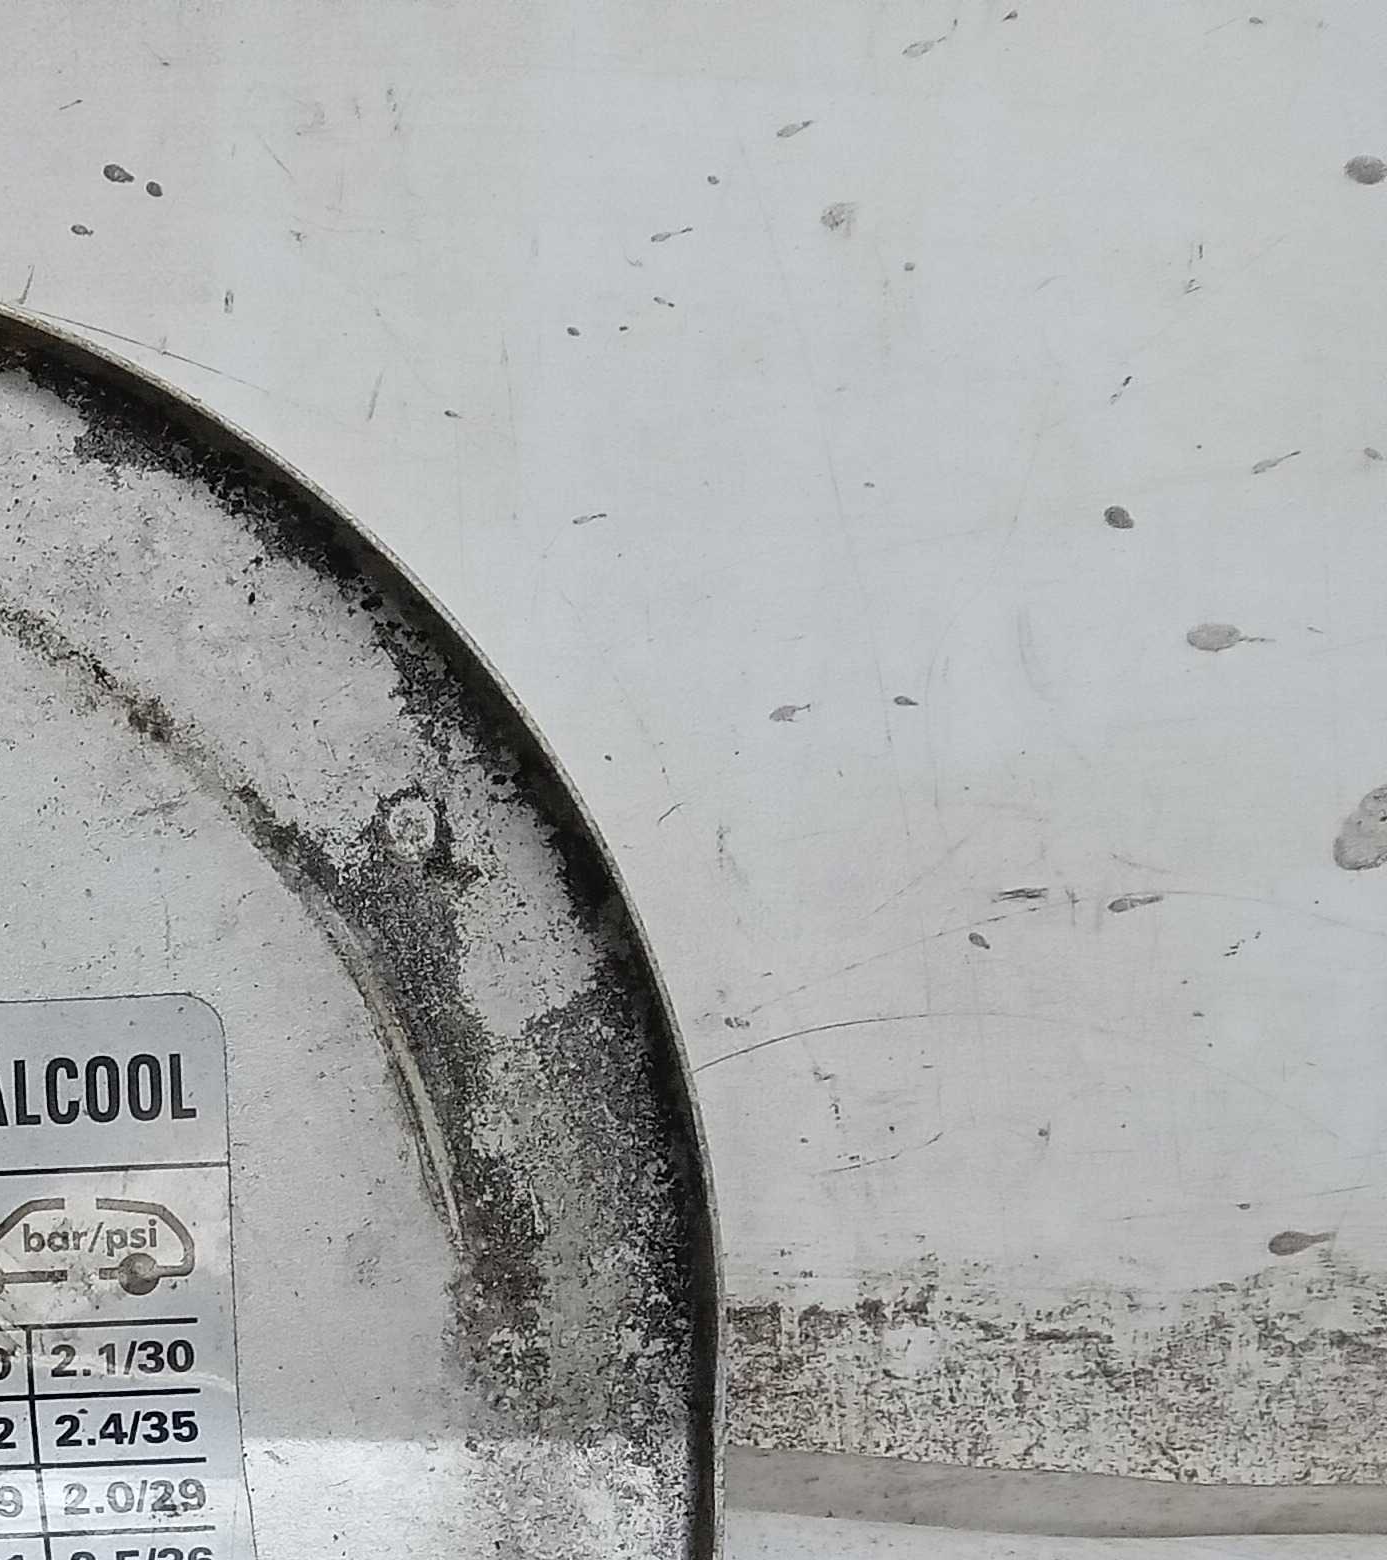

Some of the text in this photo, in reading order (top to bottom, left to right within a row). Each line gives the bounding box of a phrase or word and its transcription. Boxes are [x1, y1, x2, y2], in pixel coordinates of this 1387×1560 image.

[23, 1219, 158, 1258] bar/psi
[50, 1339, 195, 1378] 2.1/30
[55, 1410, 199, 1447] 2.4/35
[63, 1478, 207, 1515] 2.0/29
